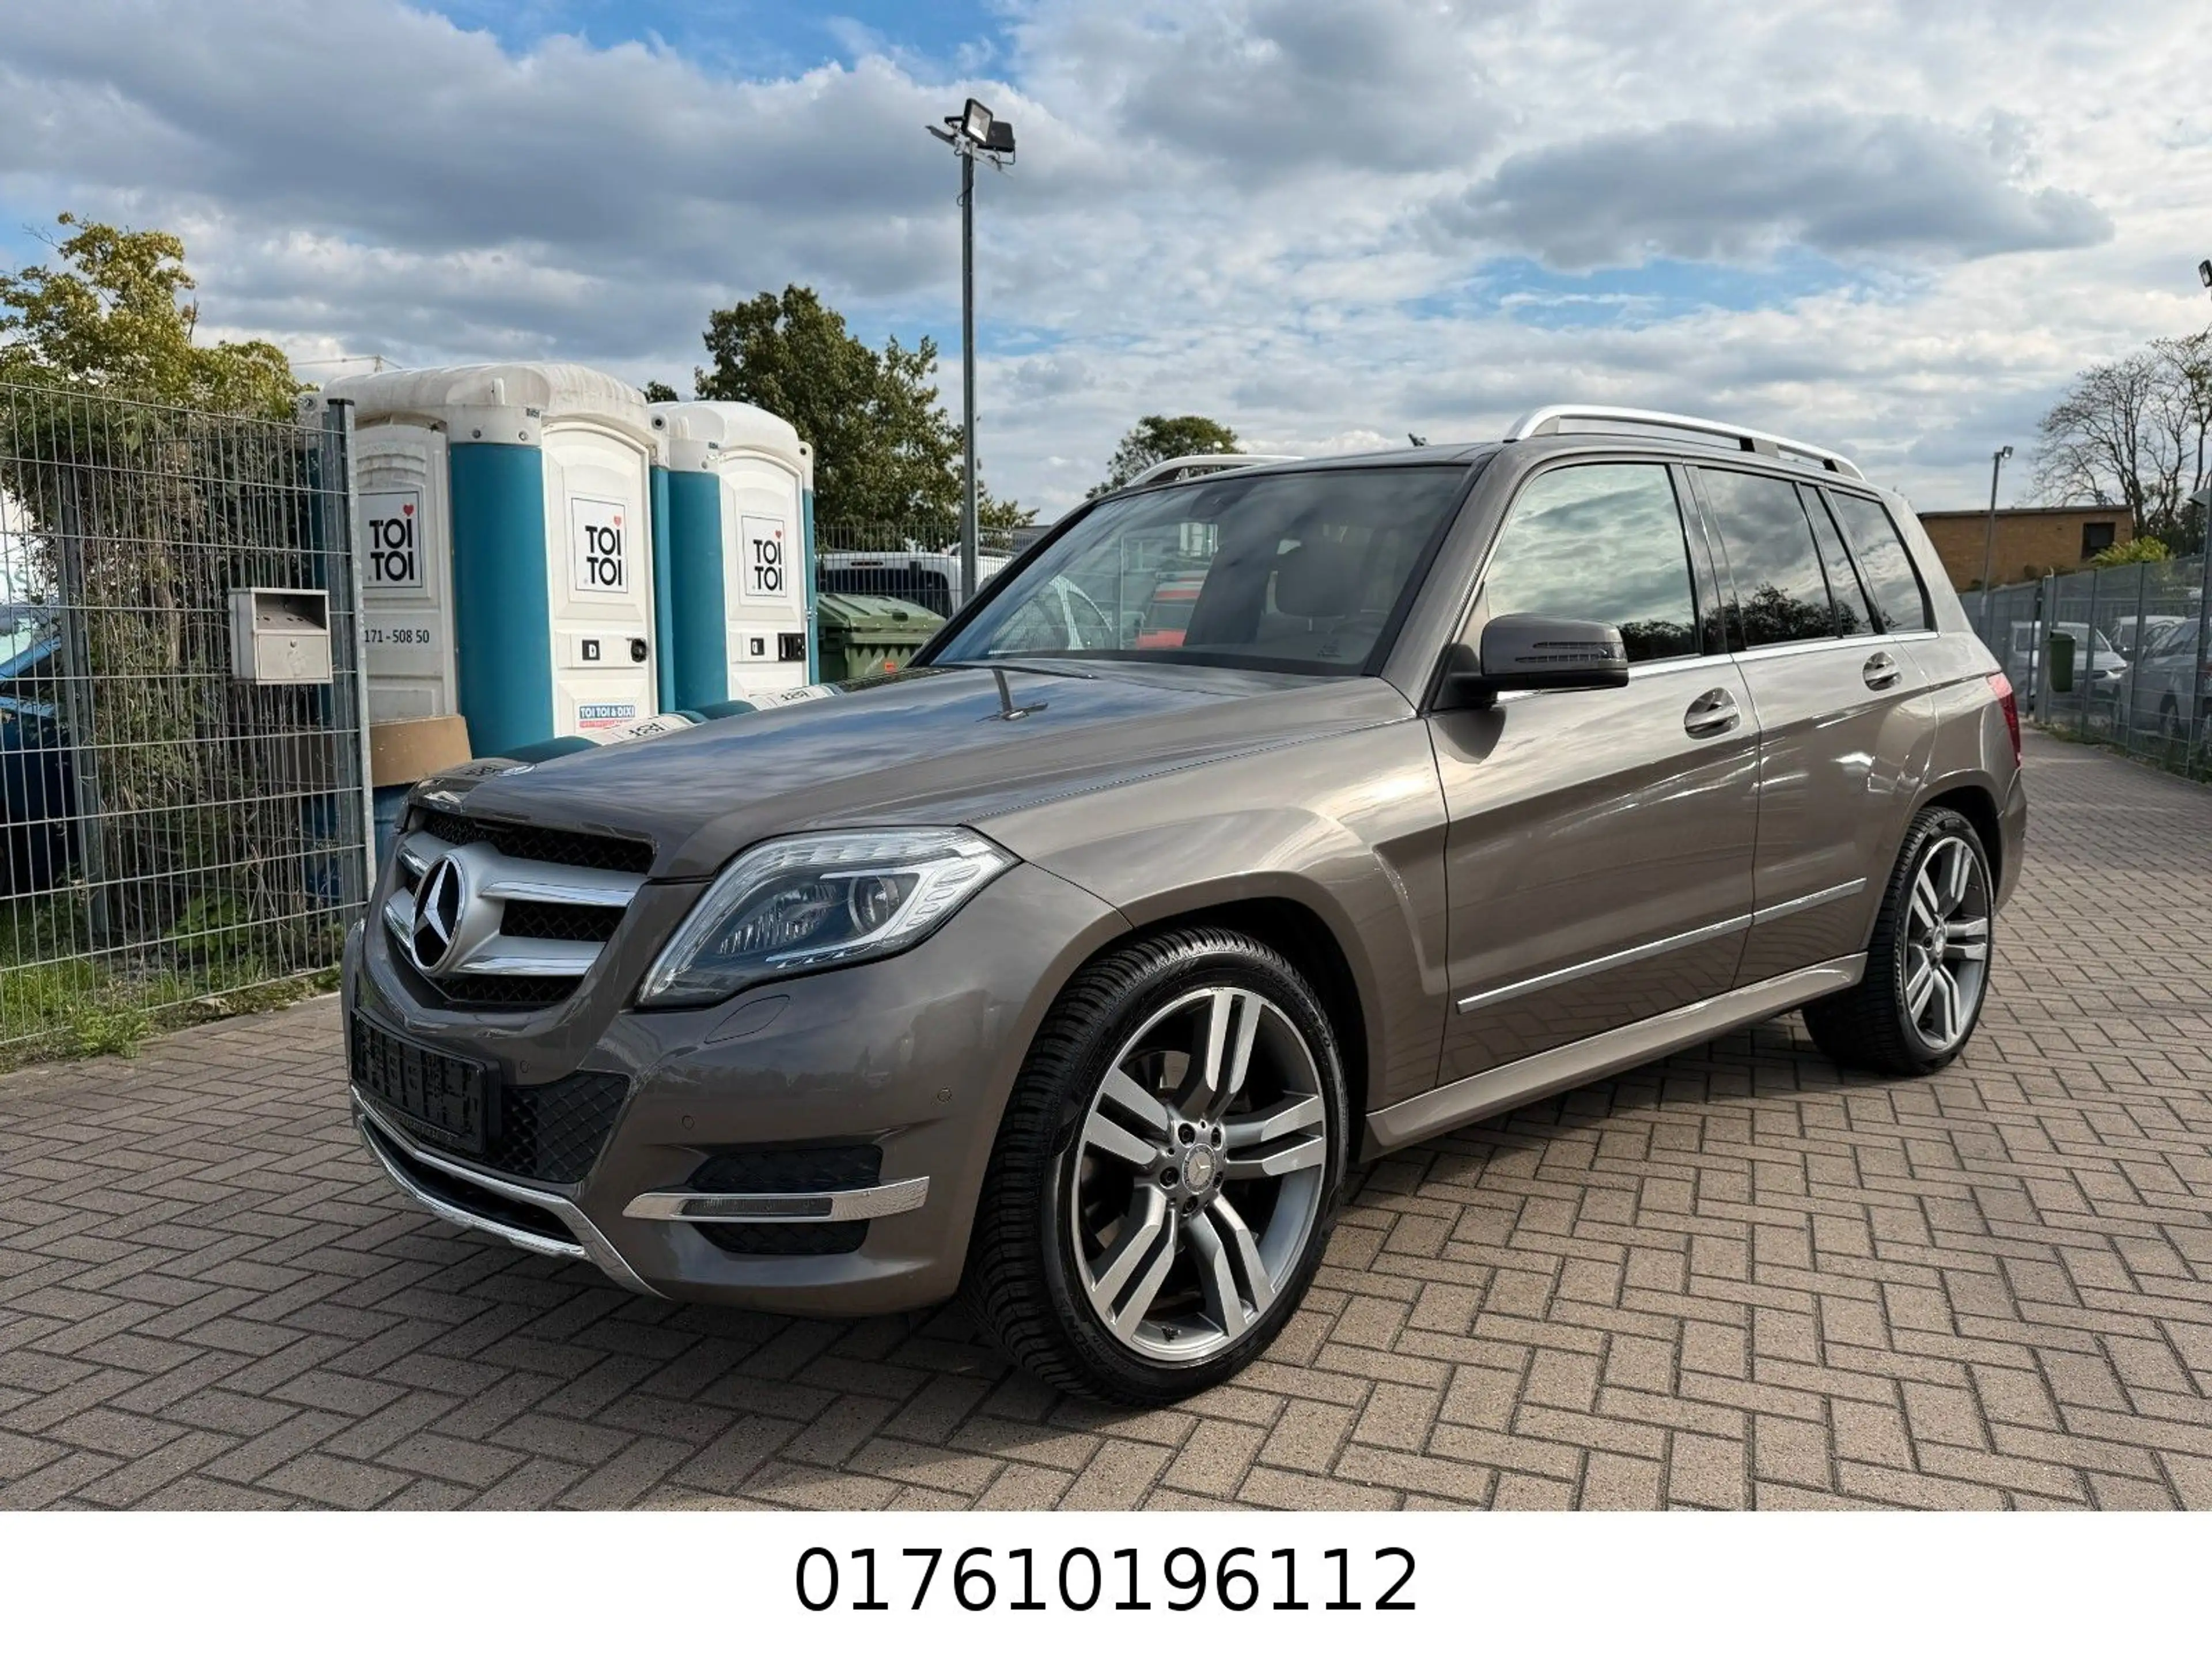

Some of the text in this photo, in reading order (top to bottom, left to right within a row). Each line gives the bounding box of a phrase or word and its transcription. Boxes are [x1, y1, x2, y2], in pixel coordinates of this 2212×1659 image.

[369, 518, 413, 549] TOI
[585, 525, 621, 556] TOI
[370, 550, 414, 581] TOI
[753, 539, 782, 565] TOI
[586, 556, 622, 586] TOI
[755, 566, 782, 591] TOI
[416, 629, 429, 643] 50
[580, 706, 635, 718] TOI TOI & DIXI
